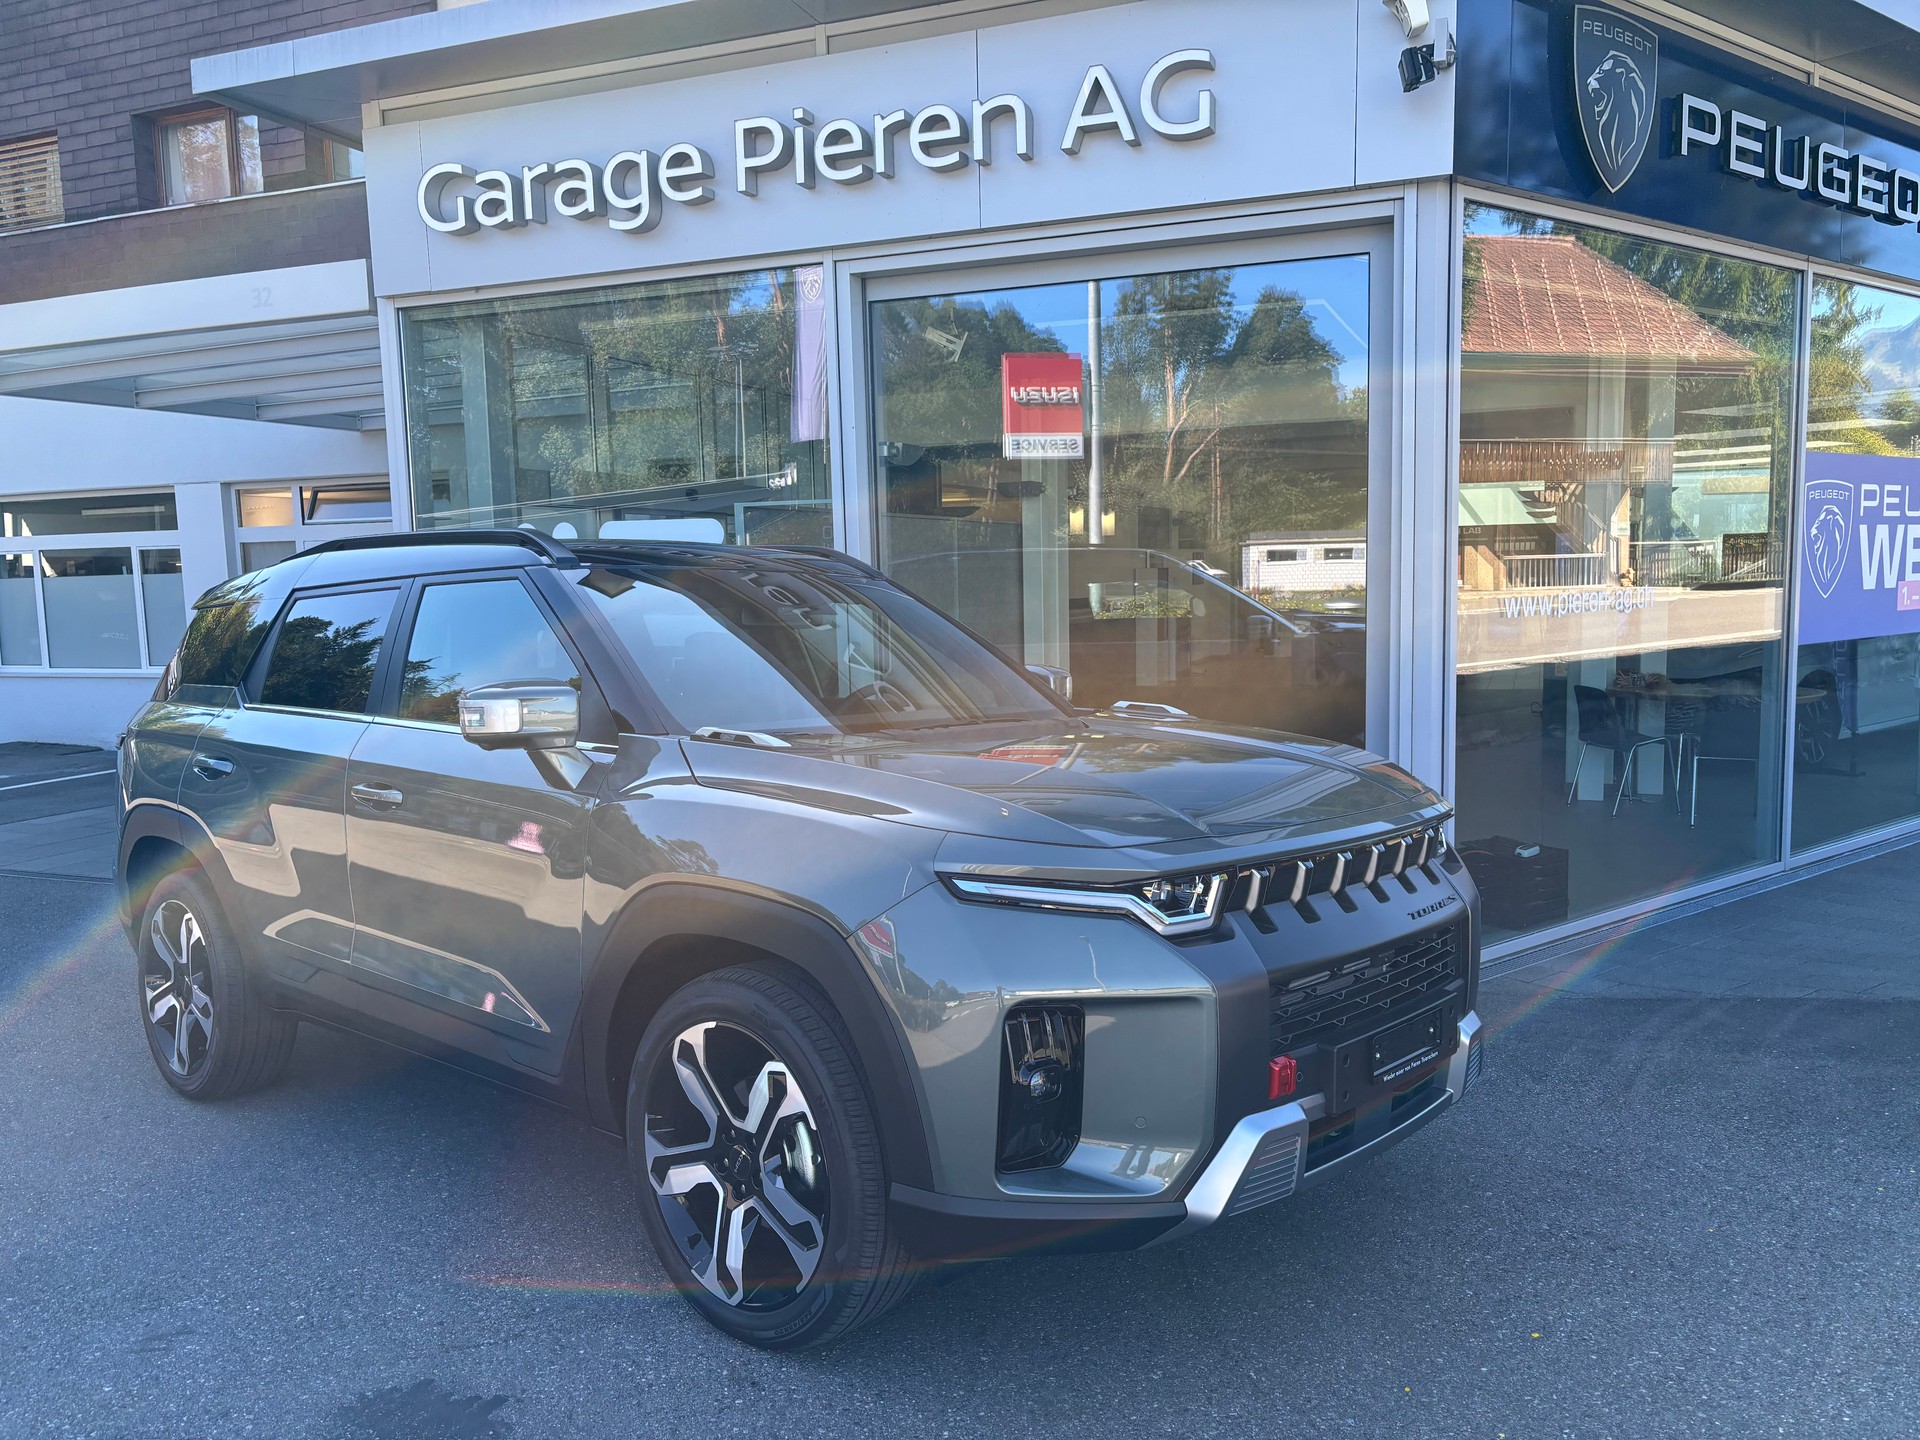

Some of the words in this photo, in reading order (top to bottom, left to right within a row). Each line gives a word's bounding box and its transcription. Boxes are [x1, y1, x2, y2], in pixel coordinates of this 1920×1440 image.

[1582, 20, 1652, 55] PEUGEOT
[417, 141, 714, 234] Garage
[734, 92, 1034, 197] Pieren
[1059, 48, 1216, 156] AG
[251, 286, 273, 308] 32
[1808, 488, 1851, 501] PEUGEOT
[1504, 585, 1655, 619] www.pieren-ag.ch
